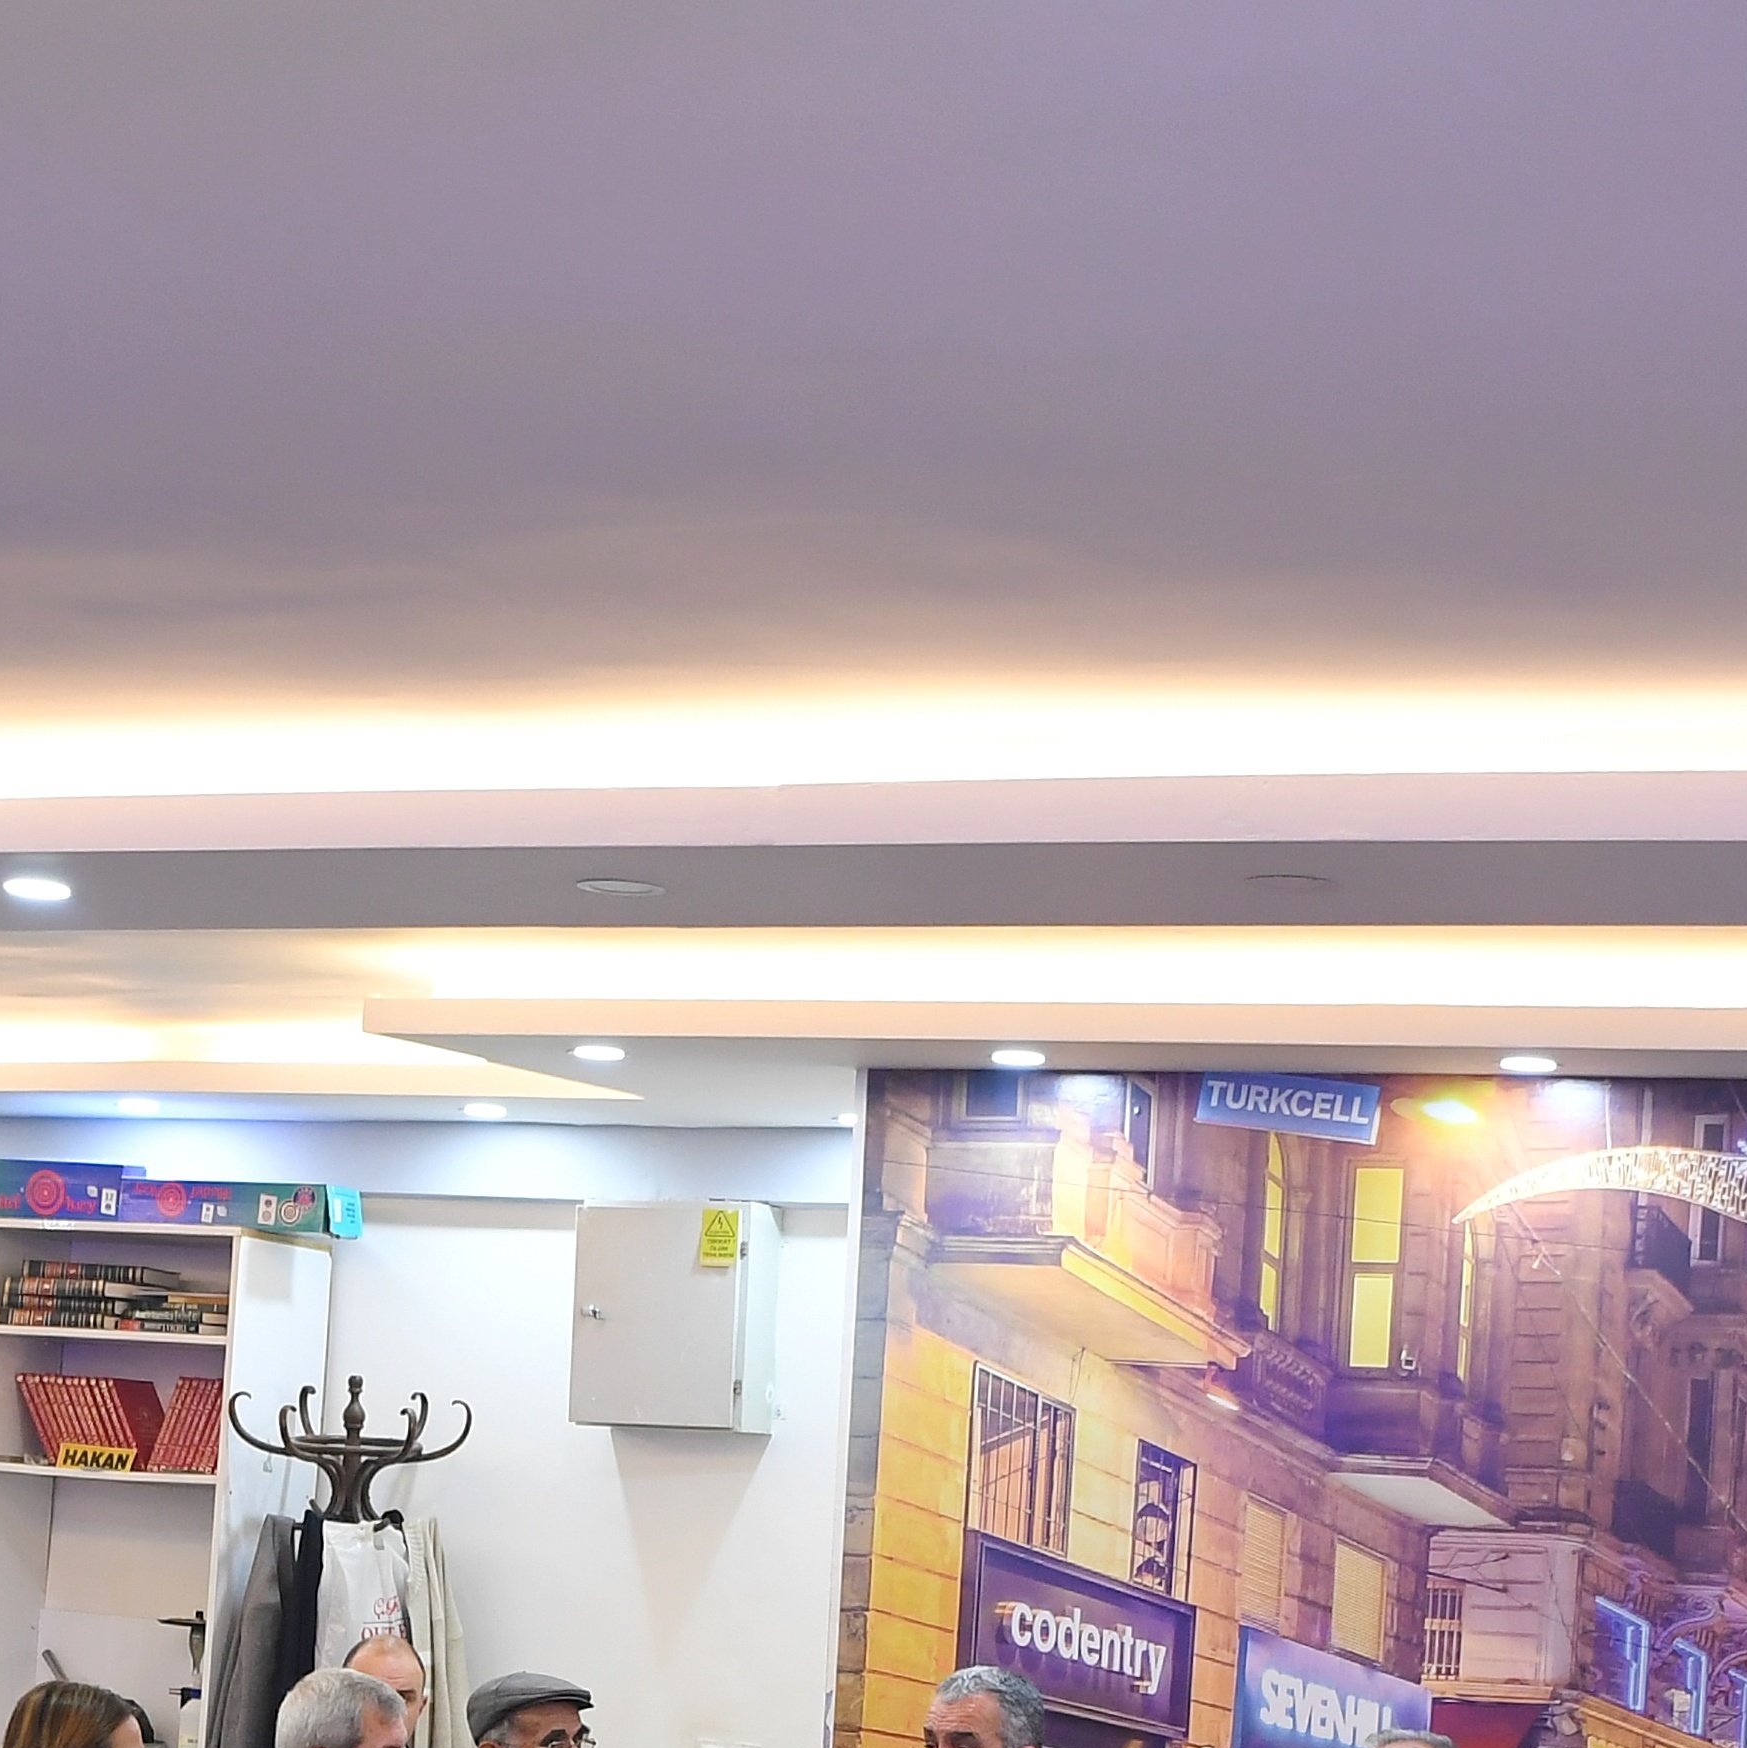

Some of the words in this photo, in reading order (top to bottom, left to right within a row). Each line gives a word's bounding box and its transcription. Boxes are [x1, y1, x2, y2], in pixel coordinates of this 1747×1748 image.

[1207, 1079, 1369, 1125] TURKCELL
[63, 1448, 130, 1471] HAKAN
[1010, 1602, 1167, 1695] codentry
